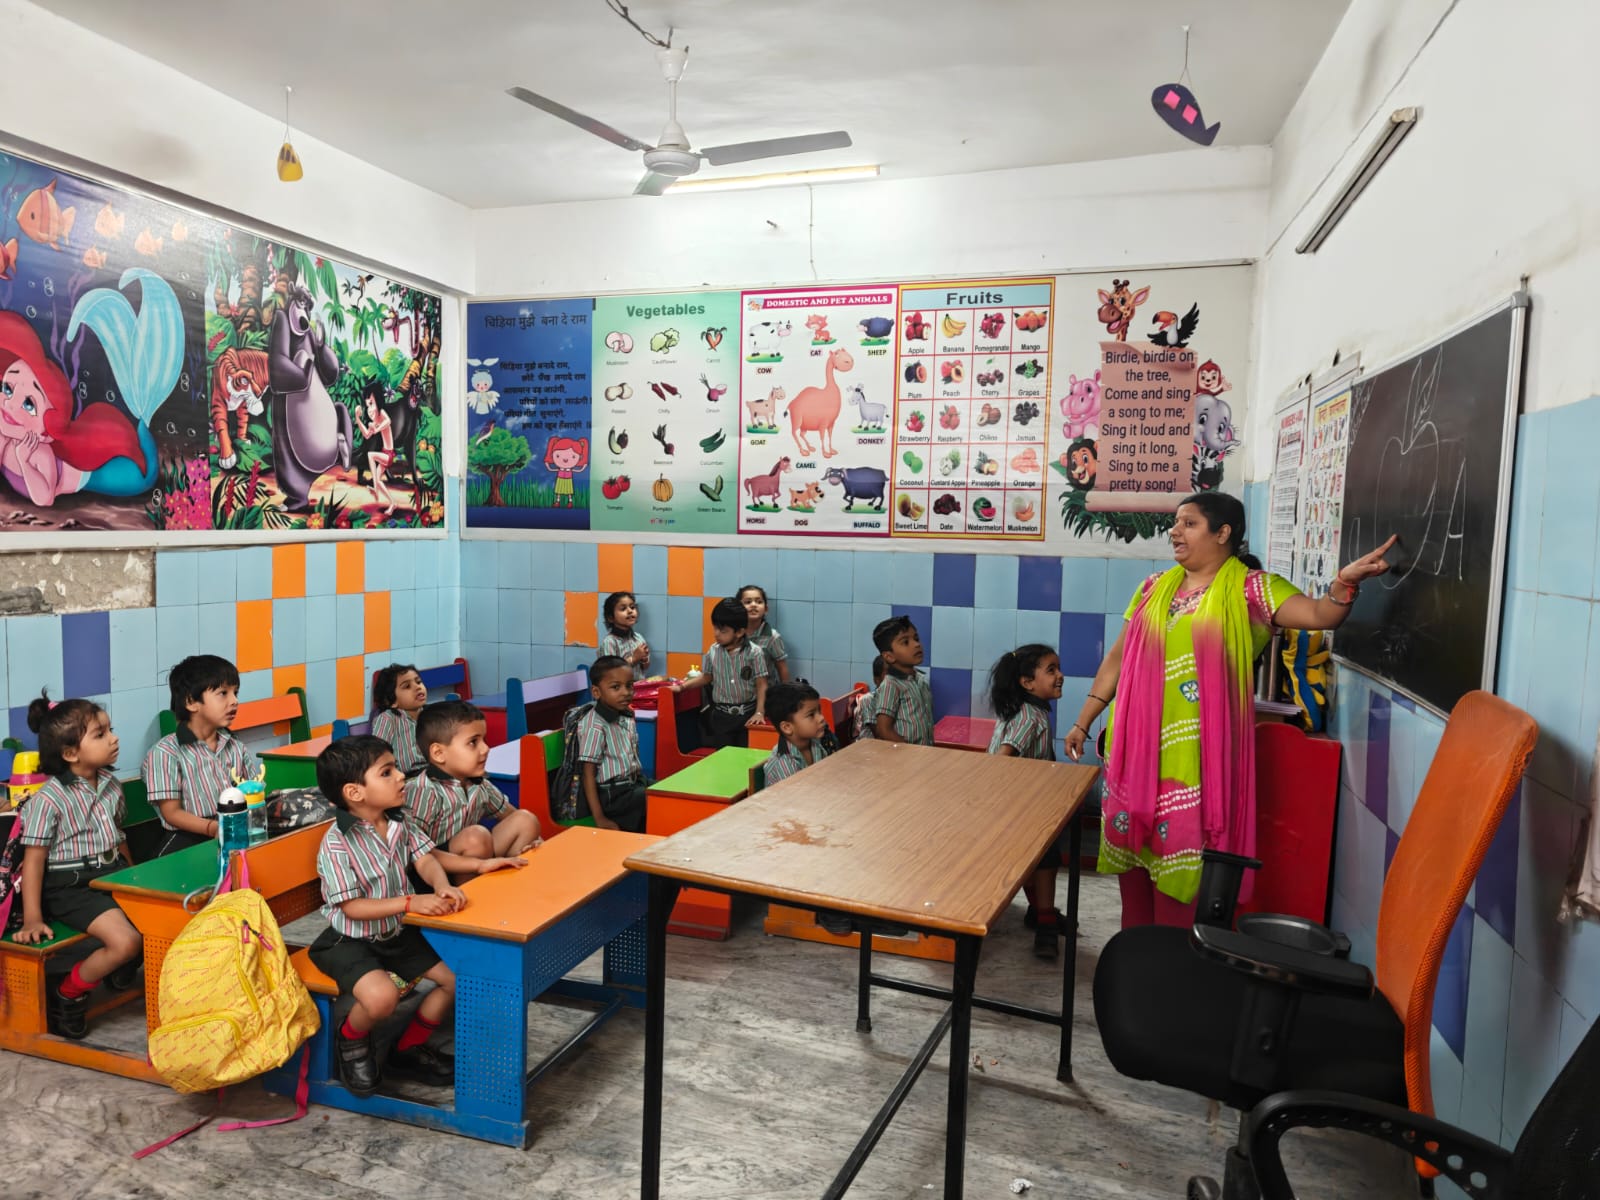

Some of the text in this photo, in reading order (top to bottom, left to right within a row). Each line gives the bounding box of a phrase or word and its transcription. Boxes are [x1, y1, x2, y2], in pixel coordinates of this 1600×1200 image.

[947, 292, 1003, 304] Fruits
[627, 304, 705, 319] Vegetables
[541, 314, 558, 326] बना
[561, 312, 567, 325] दे
[571, 314, 587, 325] राम
[1106, 351, 1193, 364] Birdie, birdie on
[1126, 369, 1171, 382] the tree,
[1105, 387, 1190, 401] Come and sing
[1109, 408, 1114, 417] a
[1118, 408, 1146, 420] song
[1150, 407, 1161, 417] to
[1102, 423, 1190, 438] Sing it loud and
[1113, 442, 1177, 456] sing it long,
[1109, 460, 1179, 474] Sing to me a
[1110, 479, 1176, 492] pretty song!
